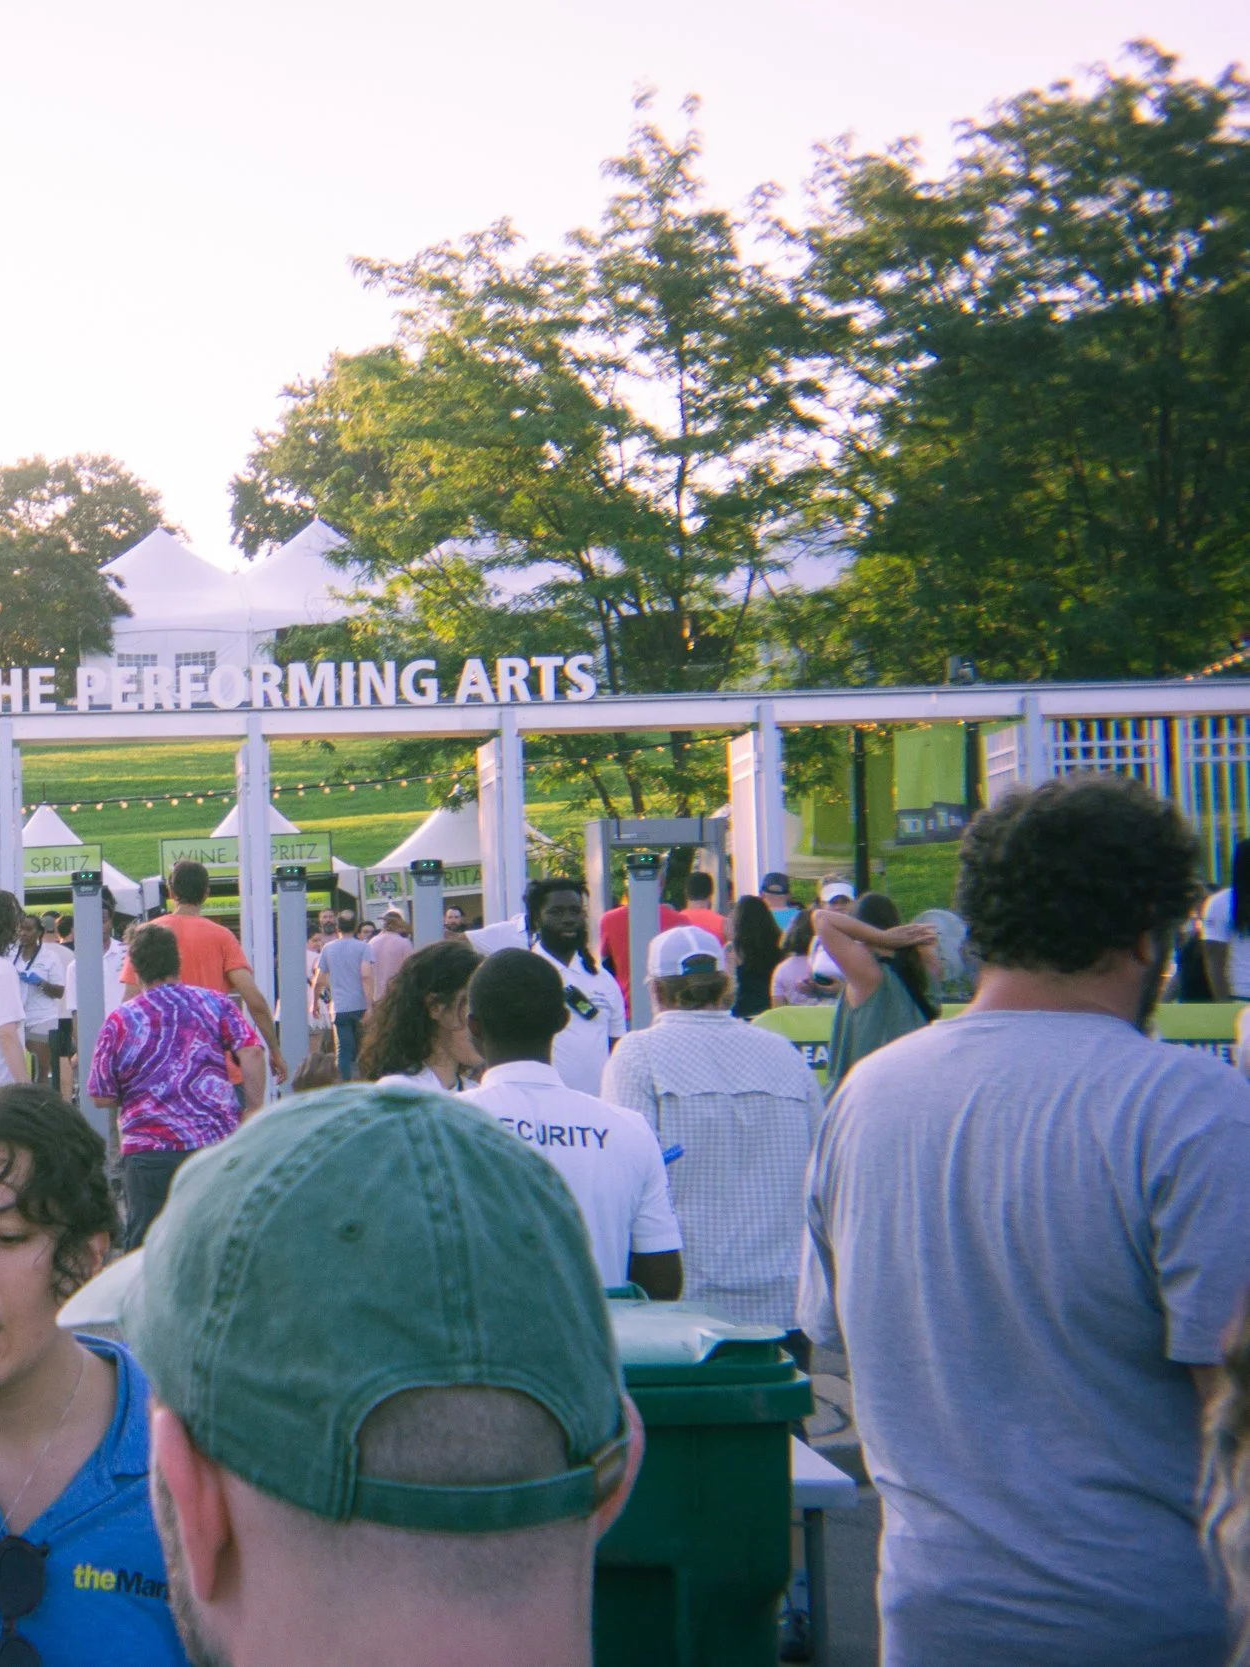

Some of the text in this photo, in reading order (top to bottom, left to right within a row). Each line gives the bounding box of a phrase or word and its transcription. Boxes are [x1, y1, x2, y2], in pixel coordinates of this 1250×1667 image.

[75, 659, 439, 711] PERFORMING
[454, 654, 598, 704] ARTS
[30, 854, 90, 874] SPRITZ
[171, 846, 228, 865] WINE
[271, 842, 320, 862] PRITZ
[74, 1562, 170, 1600] theMan
